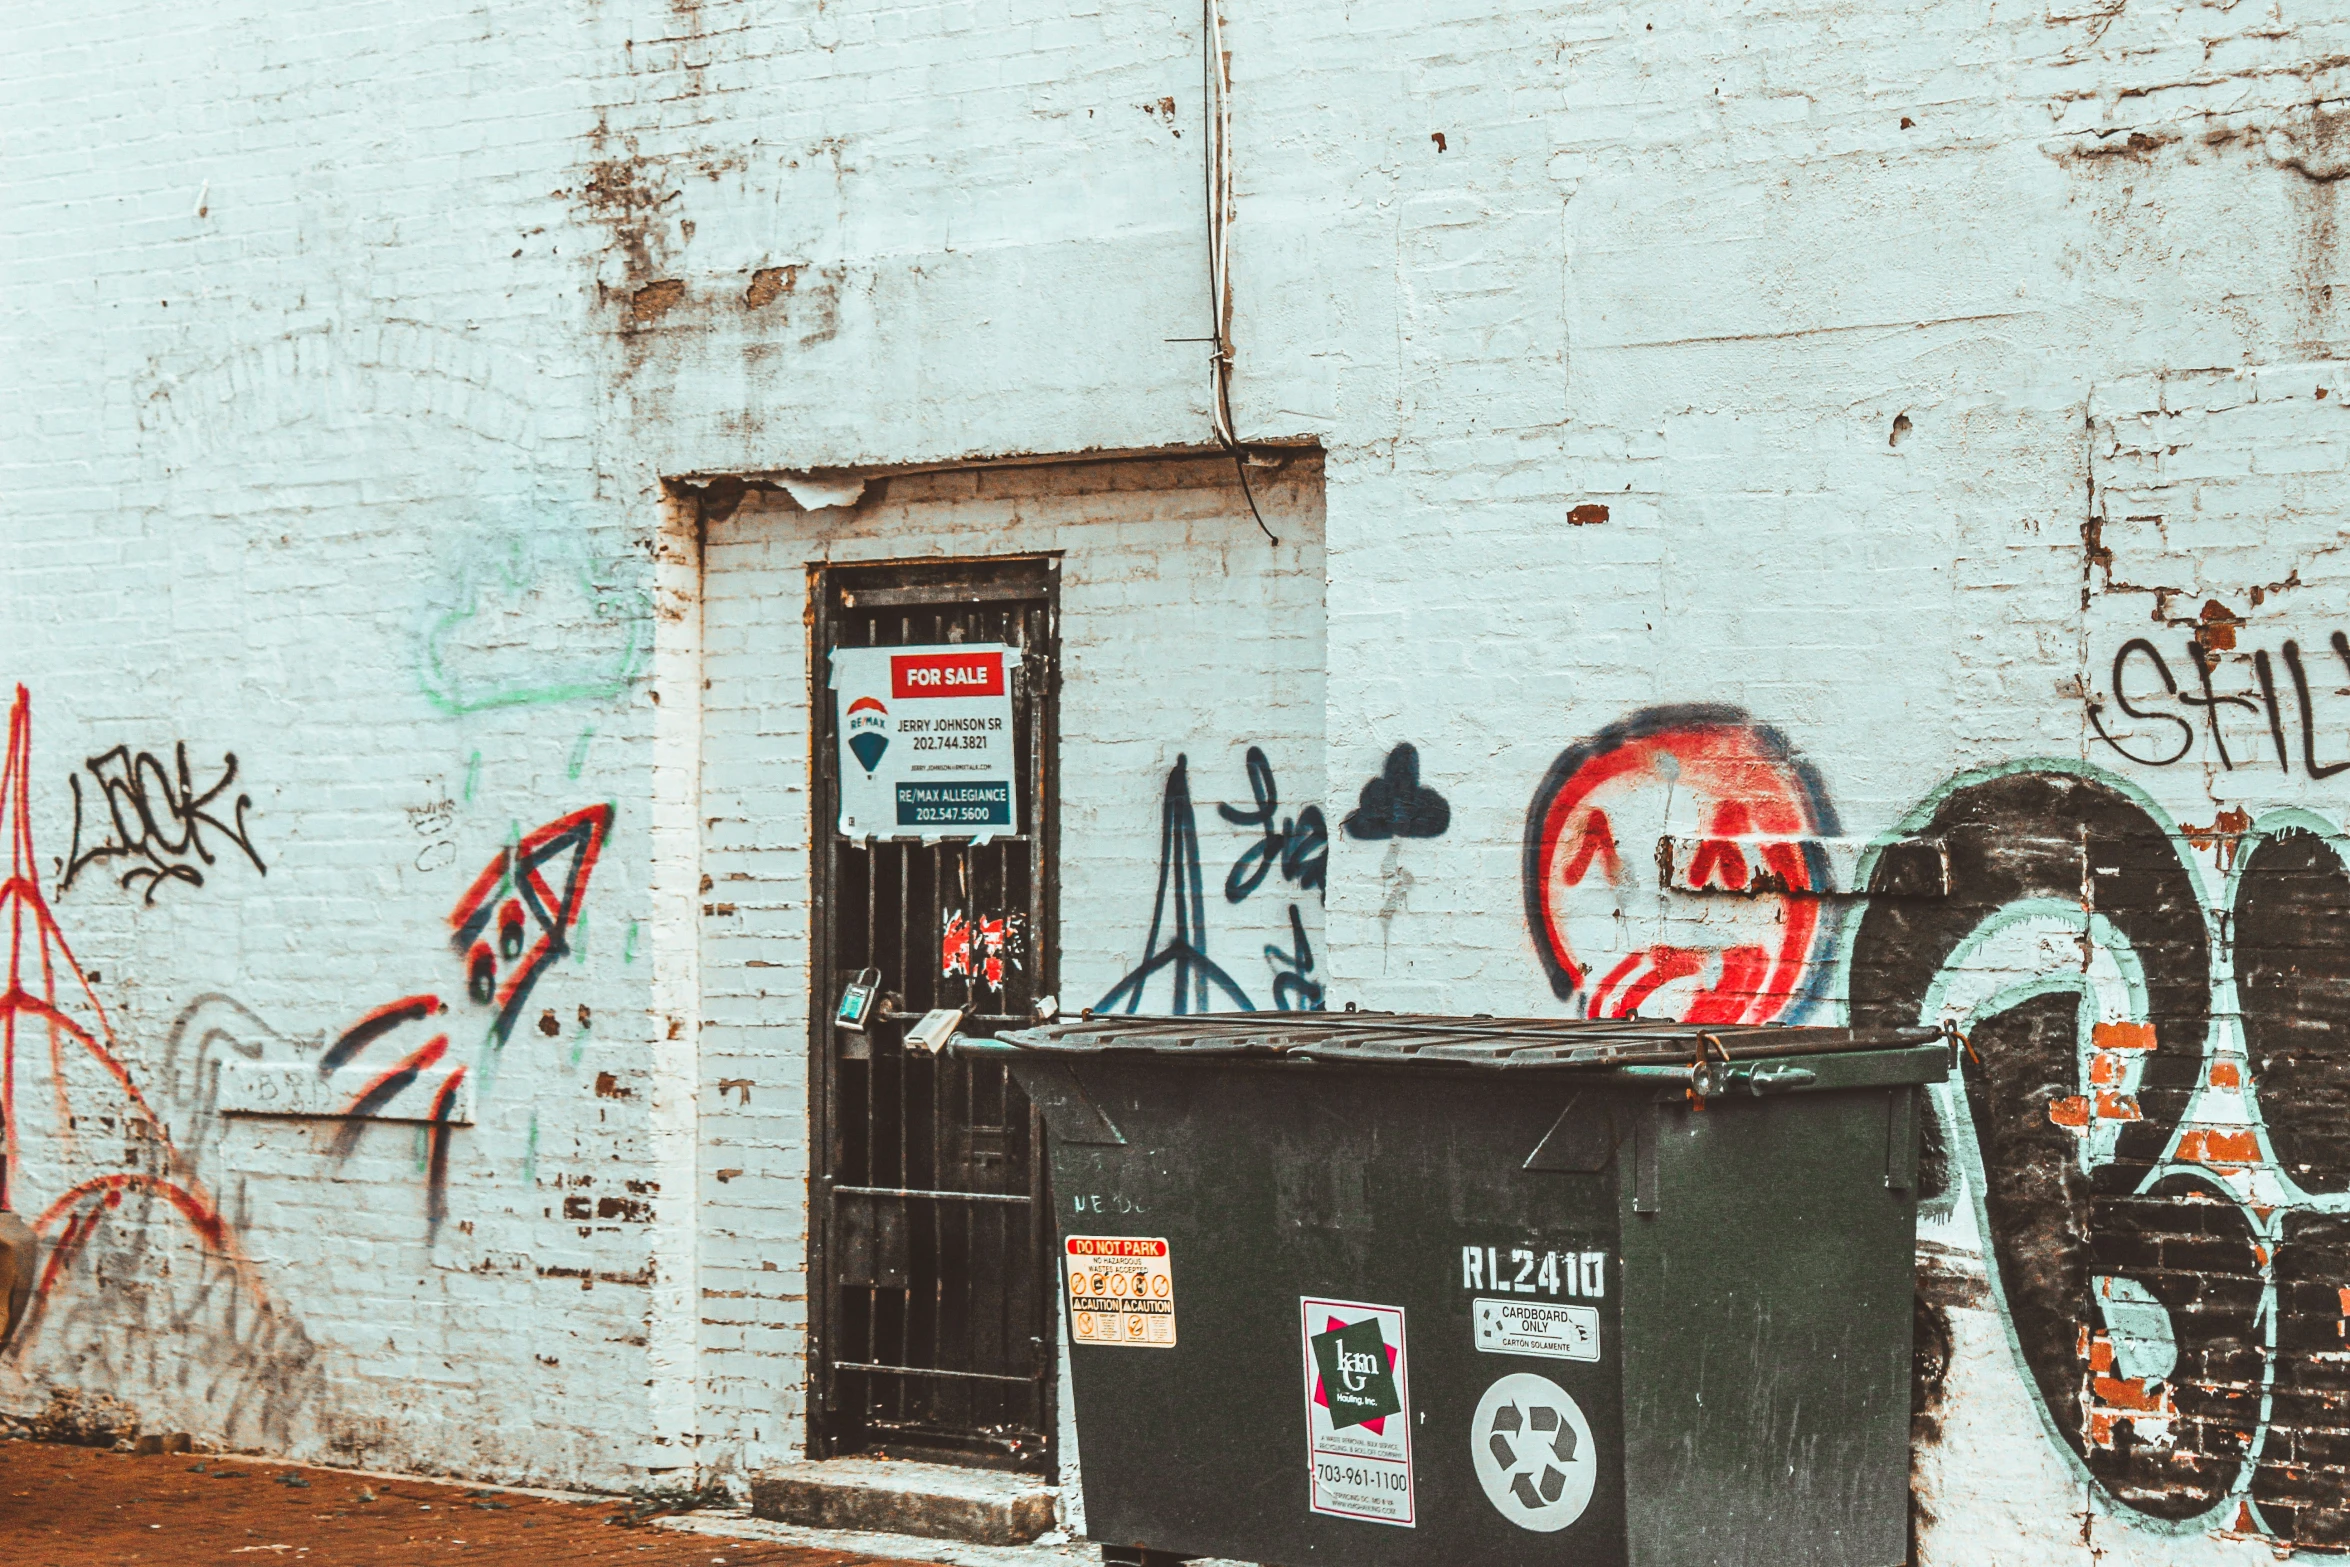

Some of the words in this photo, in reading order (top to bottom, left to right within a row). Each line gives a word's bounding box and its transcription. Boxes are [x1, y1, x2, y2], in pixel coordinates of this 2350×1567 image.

[907, 668, 941, 686] FOR
[944, 666, 988, 685] SALE
[850, 716, 885, 730] RE/MAX
[897, 719, 930, 733] JERRY
[933, 718, 985, 731] JOHNSON
[988, 718, 1002, 730] SR
[913, 736, 987, 750] 202.744.3821
[899, 789, 940, 804] RE/MAX
[942, 788, 1006, 802] ALLEGIANCE
[916, 807, 989, 821] 202.547.5600
[1076, 1240, 1093, 1254] DO
[1096, 1241, 1120, 1255] NOT
[1124, 1241, 1159, 1256] PARK
[1088, 1265, 1113, 1273] WASTES
[1103, 1258, 1142, 1266] HAZARDOUS
[1462, 1246, 1605, 1298] RL2410
[1080, 1299, 1119, 1312] CAUTION
[1130, 1300, 1171, 1313] CAUTION
[1502, 1306, 1568, 1323] CARDBOARD
[1521, 1320, 1549, 1333] ONLY
[1502, 1337, 1530, 1348] CARTÓN
[1530, 1341, 1571, 1351] SOLAMENTE
[1364, 1397, 1378, 1407] Inc.
[1317, 1464, 1407, 1492] 703-961-1100
